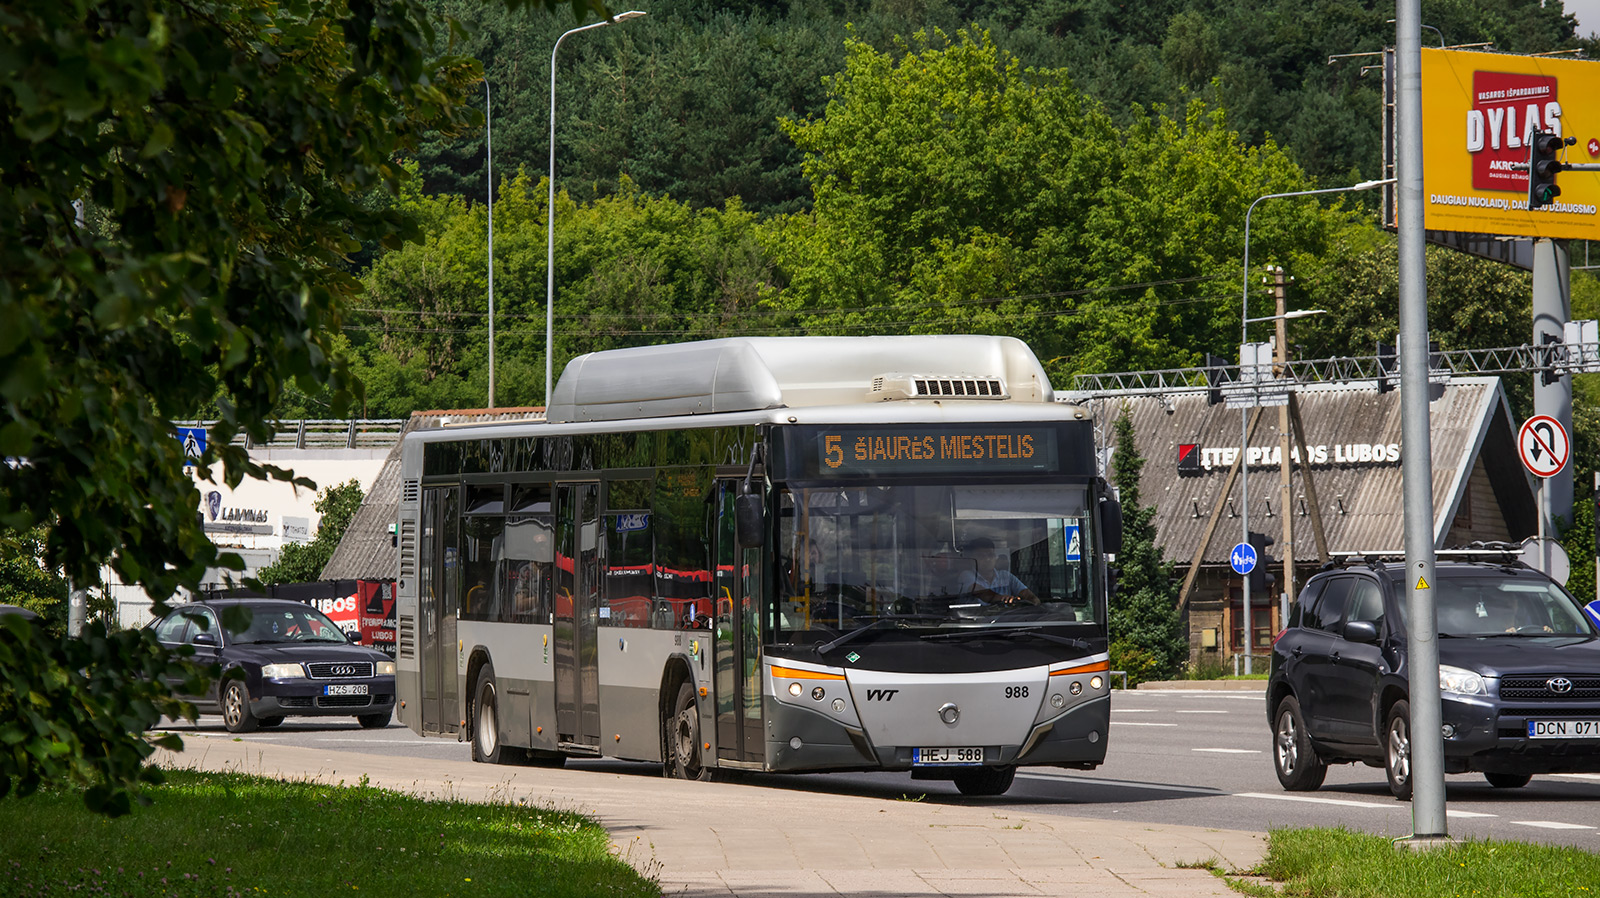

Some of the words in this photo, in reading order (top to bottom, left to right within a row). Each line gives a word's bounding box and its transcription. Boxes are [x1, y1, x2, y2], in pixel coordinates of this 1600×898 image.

[1478, 90, 1505, 100] VASAROS
[1466, 101, 1562, 152] DYLAS
[1430, 194, 1467, 205] DAUGIAU
[1468, 196, 1511, 211] NUOLAIDŲ,
[1549, 200, 1597, 215] DŽIAUGSMO
[824, 435, 844, 468] 5
[939, 434, 1035, 459] MIESTELIS
[1334, 444, 1400, 463] LUBOS
[329, 686, 348, 694] HZS
[352, 685, 367, 694] 209
[1005, 686, 1030, 699] 988
[1536, 722, 1566, 735] DCN
[1575, 722, 1599, 735] 071
[920, 748, 949, 762] HEJ
[957, 748, 982, 761] 588
